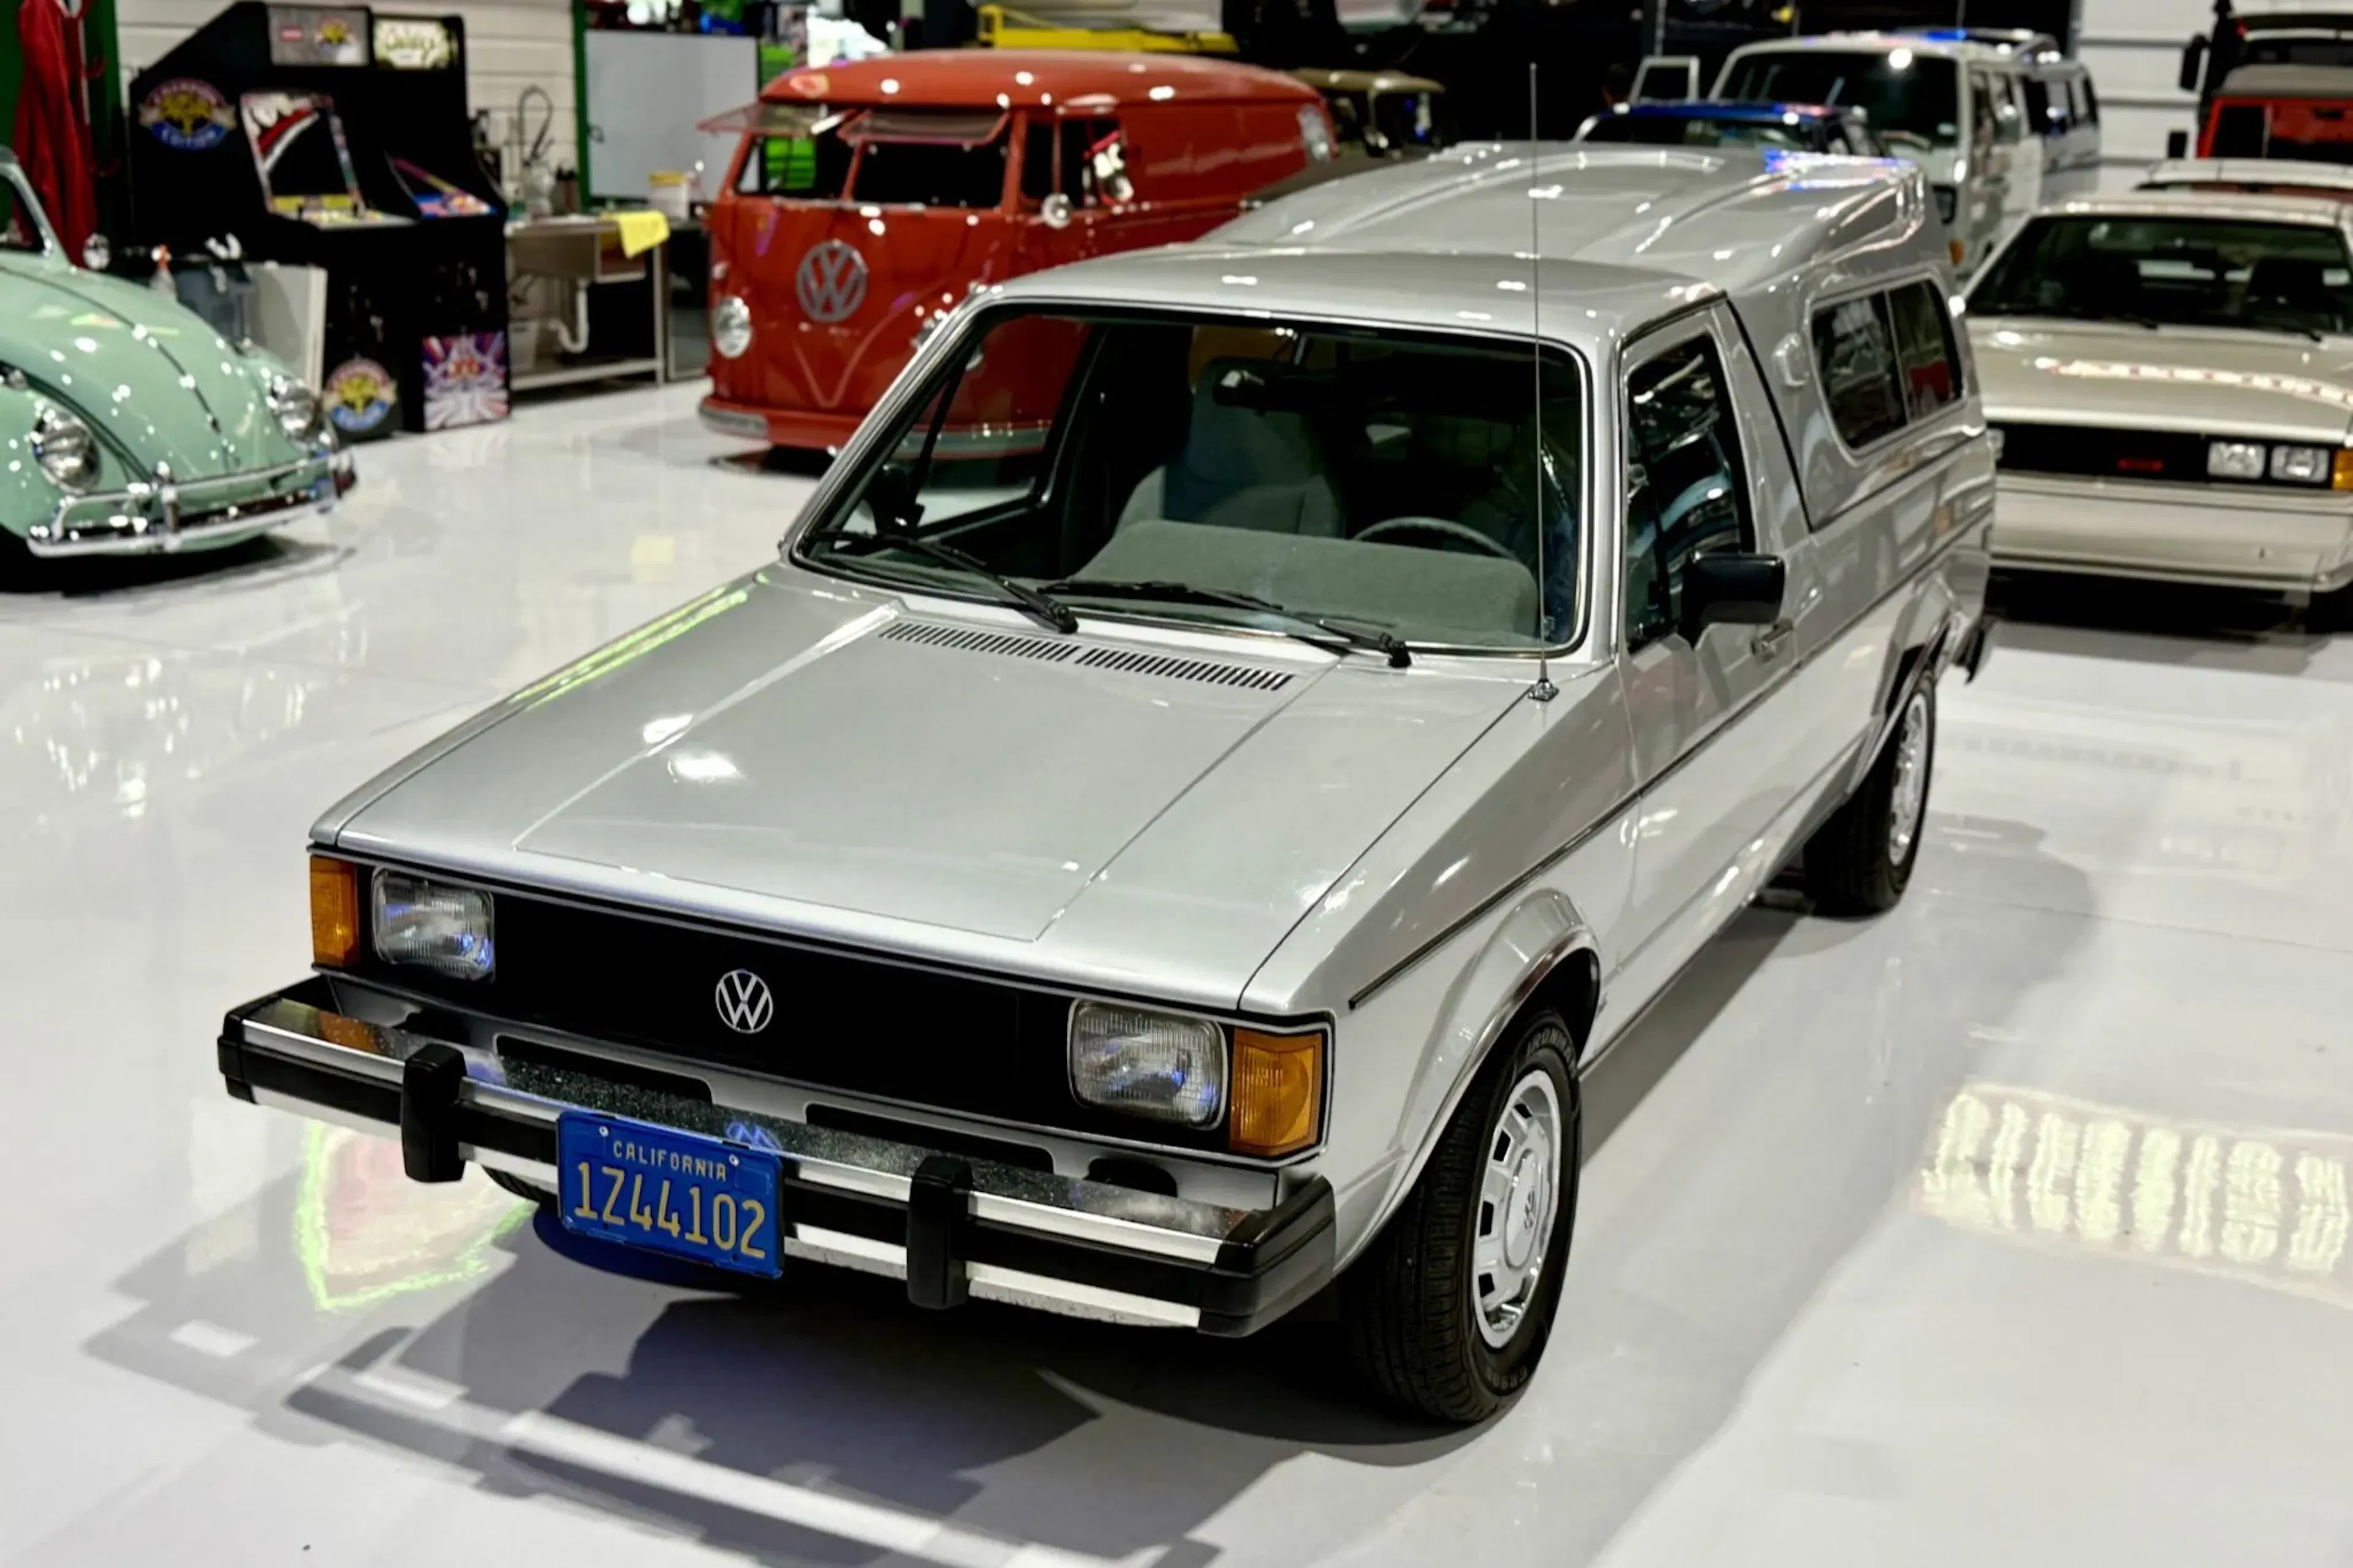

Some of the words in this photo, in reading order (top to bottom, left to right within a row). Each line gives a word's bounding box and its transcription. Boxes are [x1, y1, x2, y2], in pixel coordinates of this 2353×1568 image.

[795, 239, 869, 322] VW
[715, 969, 773, 1034] VW
[613, 1140, 727, 1181] CALIFORNIA
[574, 1162, 765, 1259] 1Z44102
